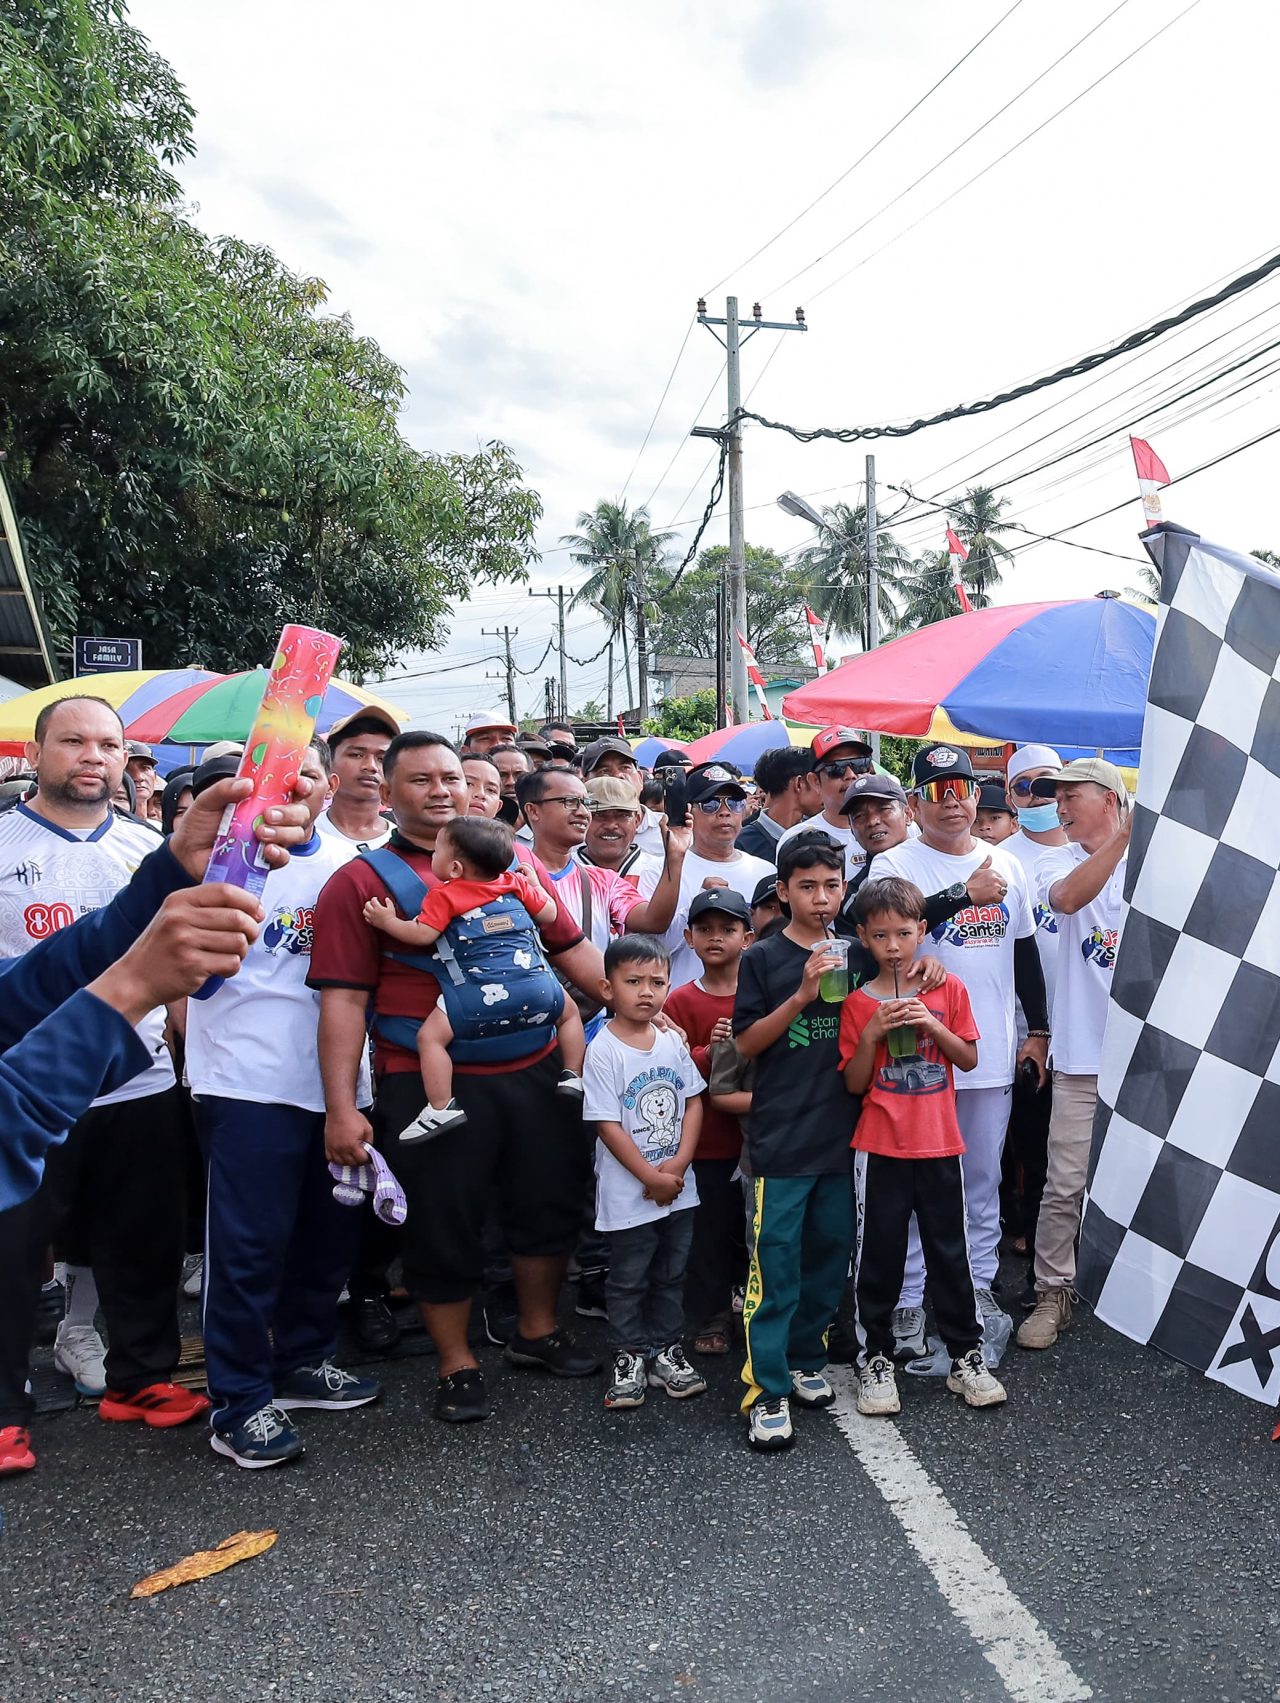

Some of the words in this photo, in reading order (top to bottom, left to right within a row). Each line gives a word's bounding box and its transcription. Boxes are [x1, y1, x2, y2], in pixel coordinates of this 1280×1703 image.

[98, 646, 117, 654] JASA
[93, 654, 122, 662] FAMILY
[24, 903, 75, 940] 80
[954, 905, 1003, 925] Jalan
[960, 922, 1005, 938] Santai
[811, 1015, 839, 1028] stan
[811, 1028, 839, 1040] cha
